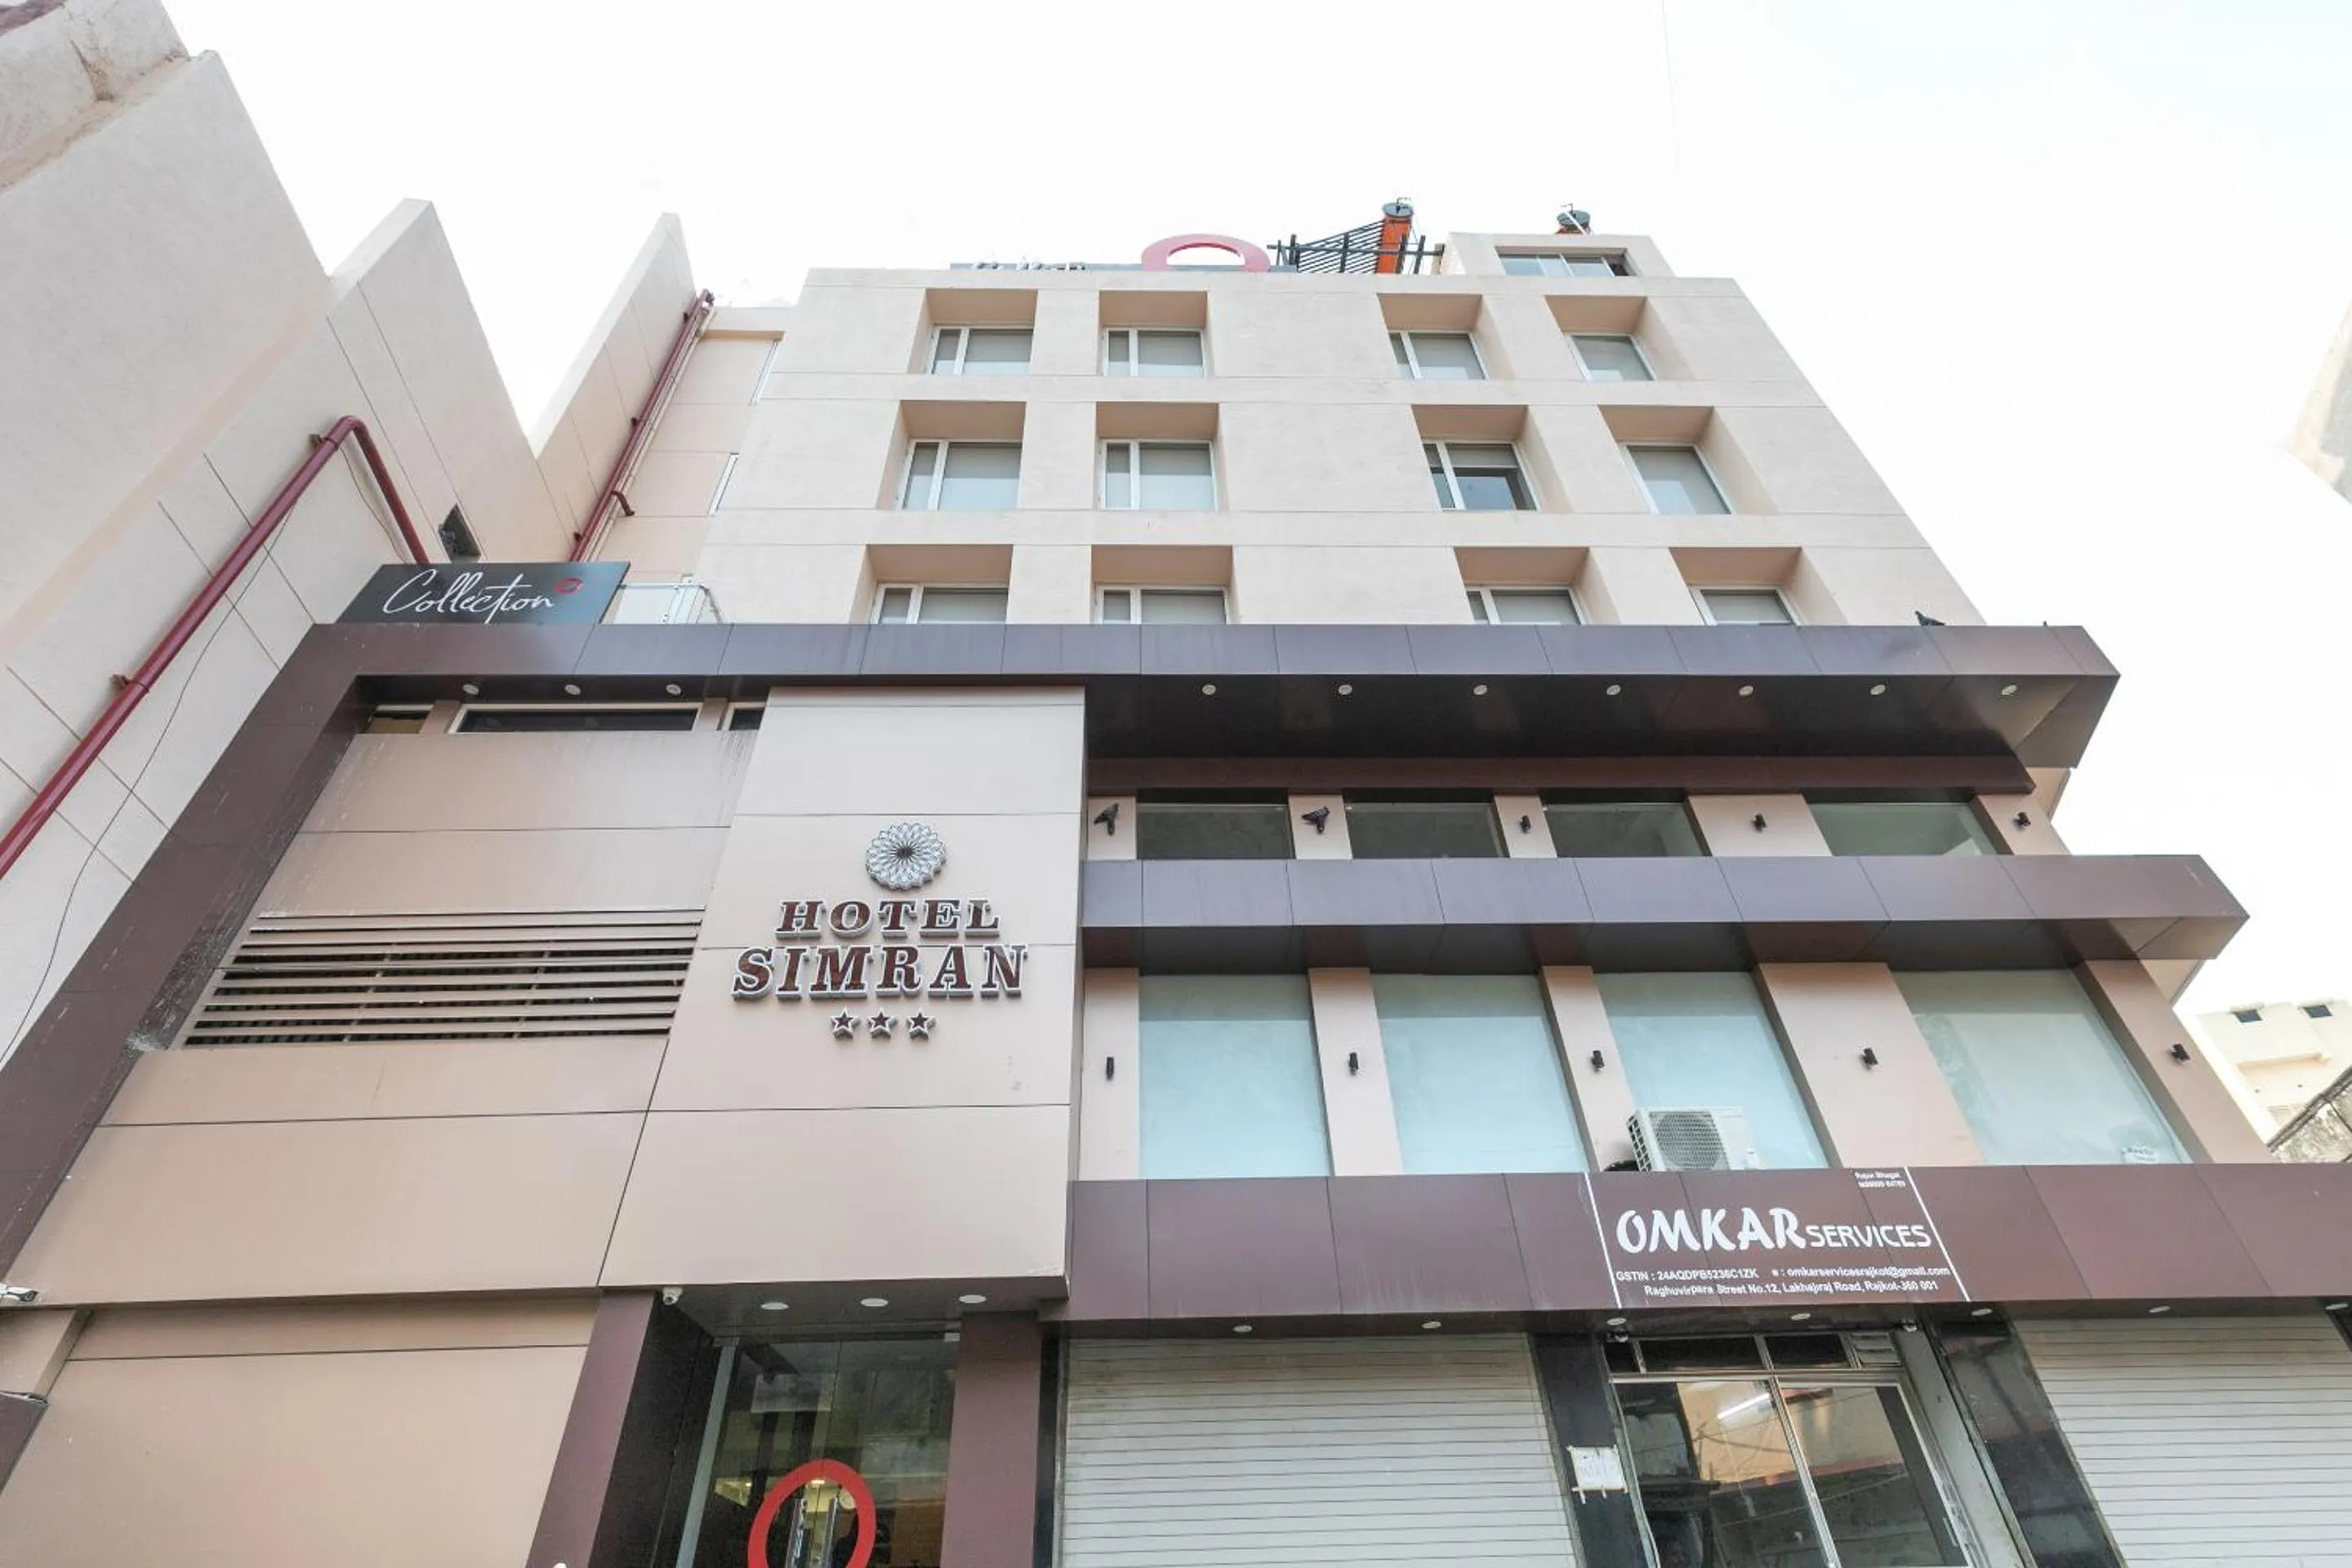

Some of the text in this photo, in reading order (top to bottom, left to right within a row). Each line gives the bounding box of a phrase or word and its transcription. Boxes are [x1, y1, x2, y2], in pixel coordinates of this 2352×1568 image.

[382, 568, 555, 624] Collection
[775, 898, 1000, 939] HOTEL
[732, 943, 1029, 1000] SIMRAN
[1616, 1207, 1932, 1254] OMKAR SERVICES
[1616, 1271, 1649, 1281] GSTIN
[1717, 1284, 1746, 1294] Street
[1833, 1281, 1864, 1293] Road,
